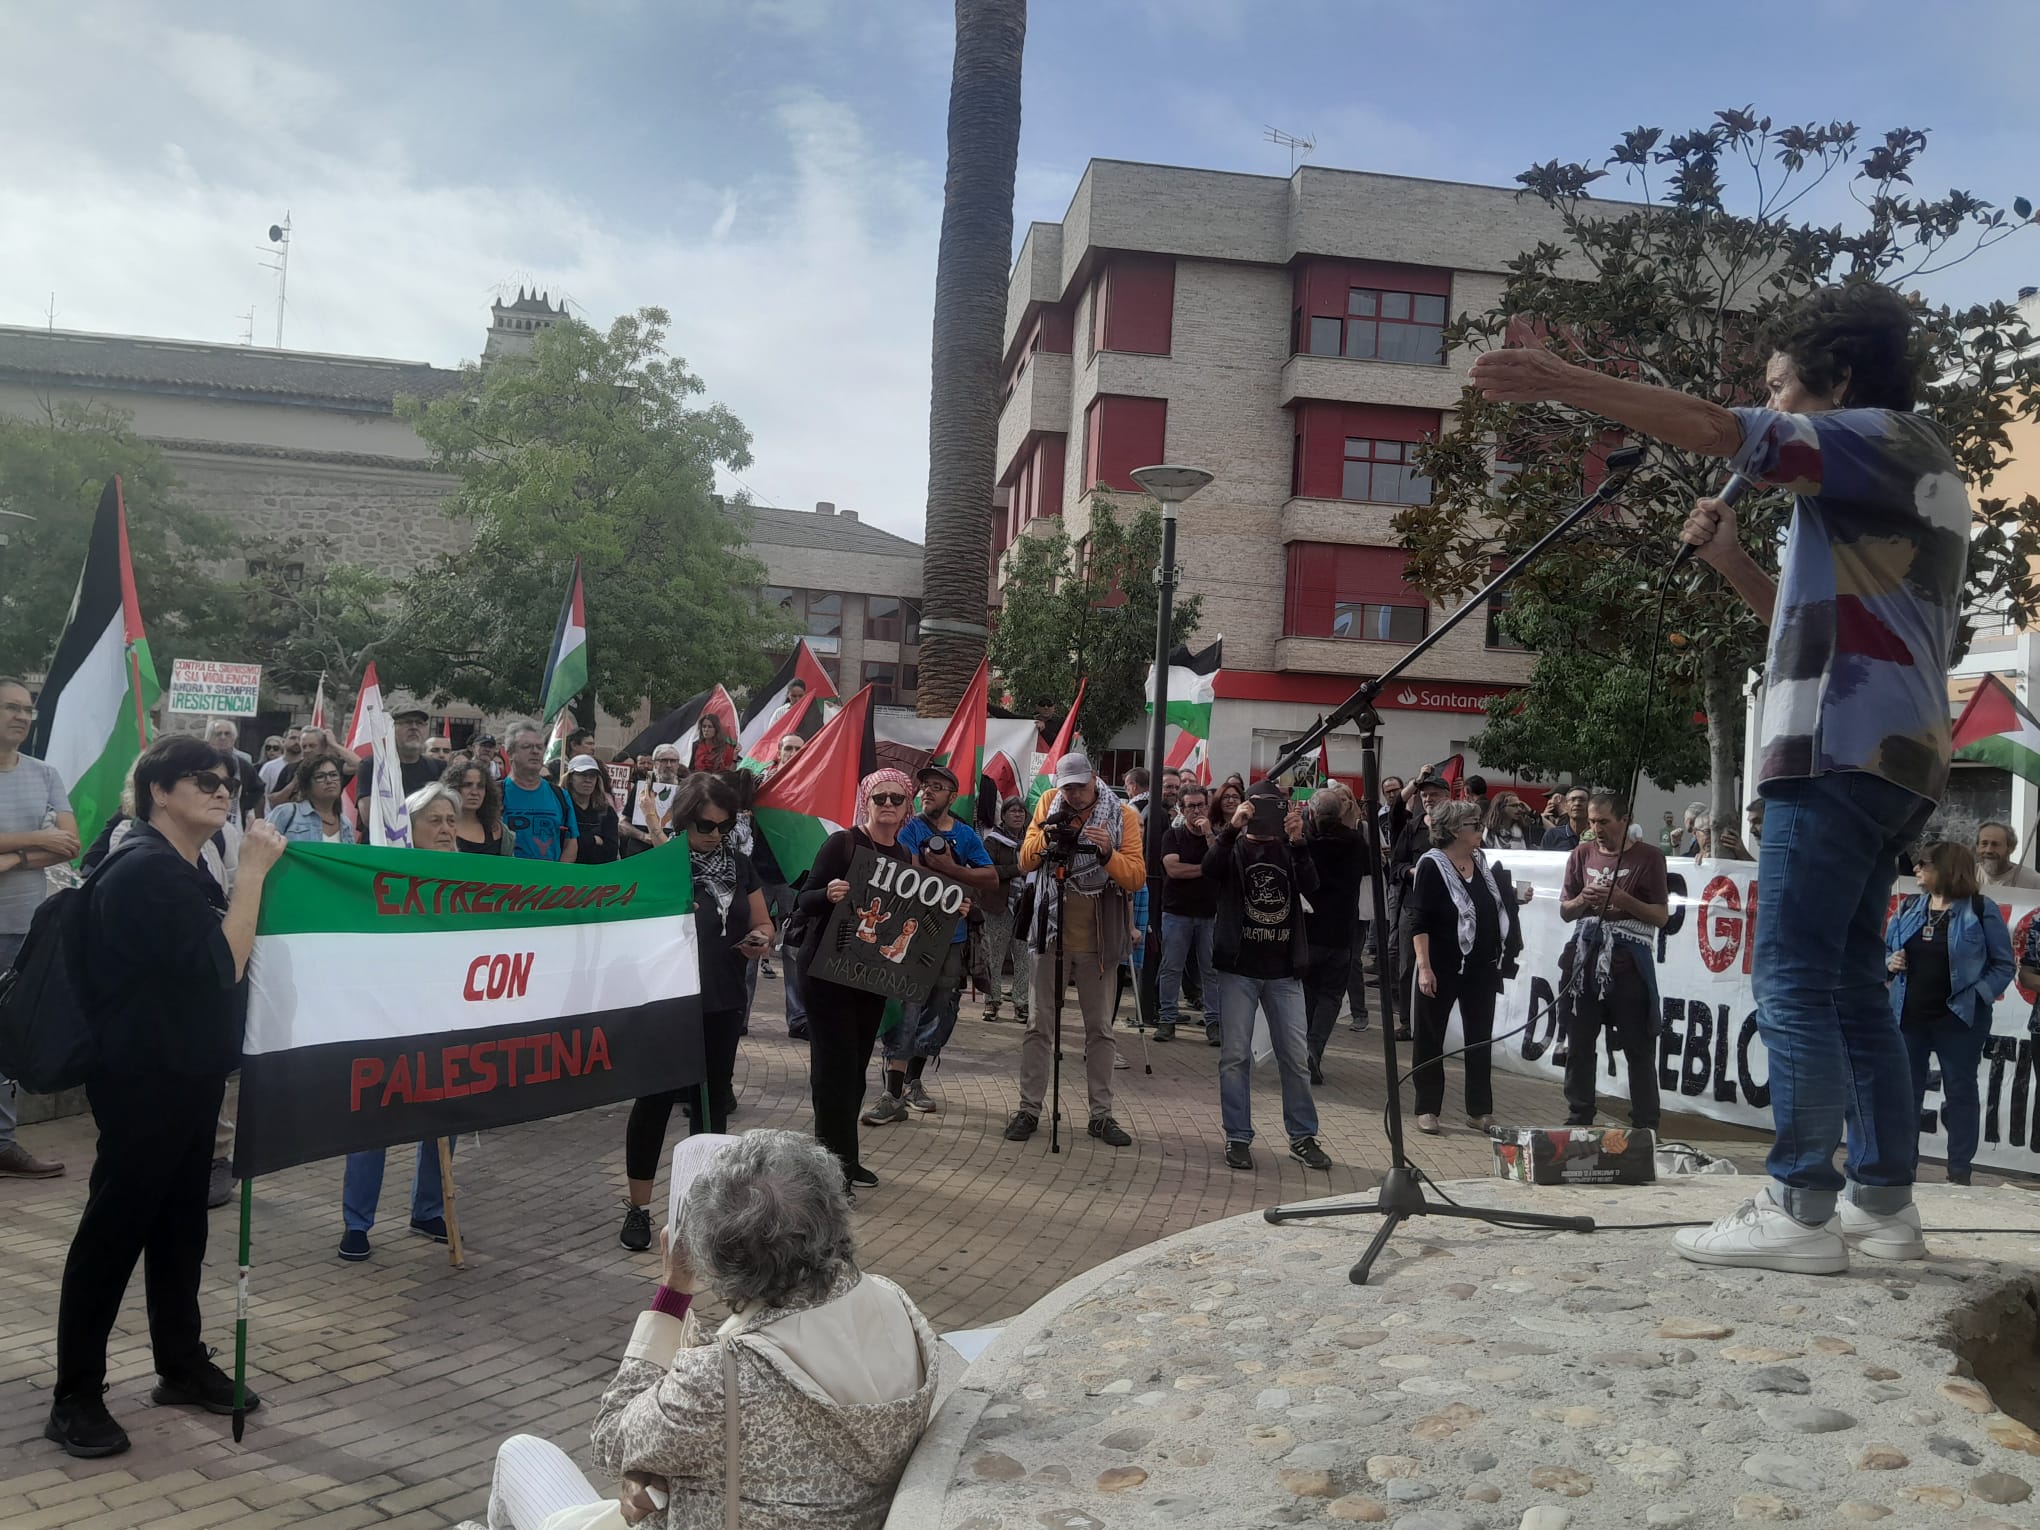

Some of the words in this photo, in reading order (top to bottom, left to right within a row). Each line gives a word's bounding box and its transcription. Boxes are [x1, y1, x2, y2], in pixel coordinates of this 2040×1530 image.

[174, 661, 206, 672] CONTRA
[207, 663, 217, 672] EL
[219, 664, 260, 675] SIONISMO
[174, 671, 182, 681] Y
[183, 671, 199, 682] SU
[202, 672, 258, 685] VIOLENCIA
[171, 692, 256, 713] ¡RESISTENCIA!
[172, 682, 204, 693] AHORA
[206, 685, 213, 693] Y
[214, 685, 258, 696] SIEMPRE
[372, 870, 638, 916] EXTREMADURA
[868, 856, 964, 915] 11000
[462, 951, 535, 1002] CON
[351, 1026, 613, 1112] PALESTINA
